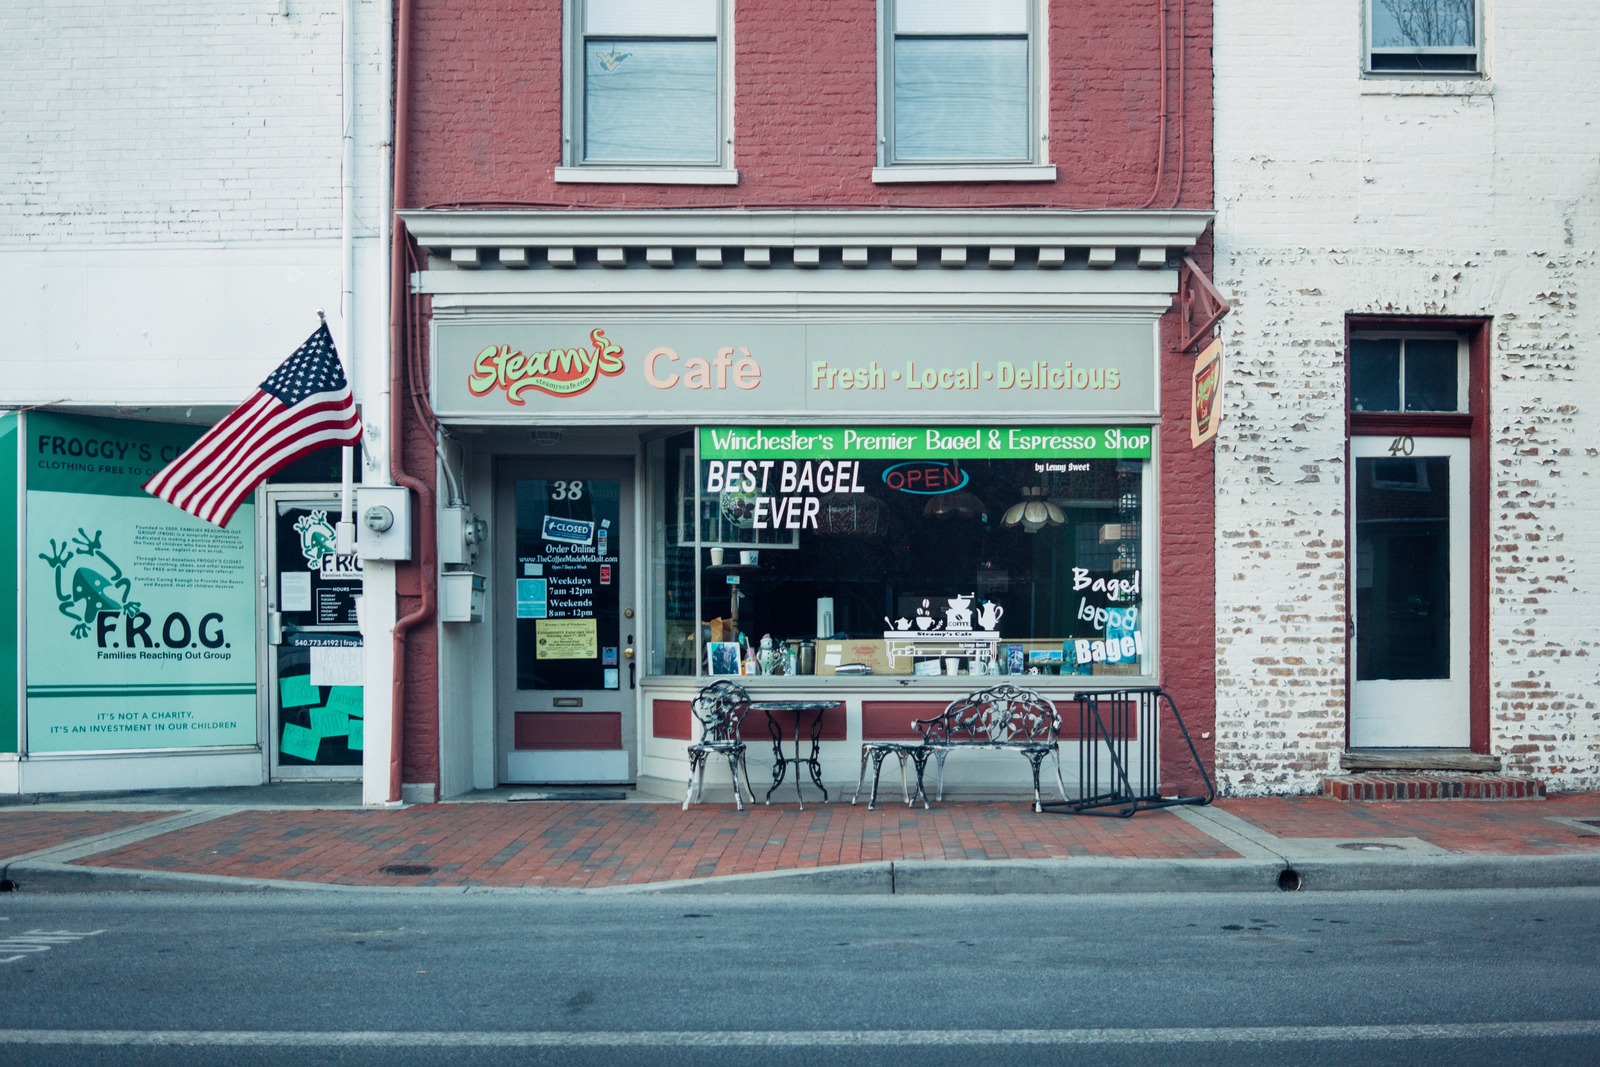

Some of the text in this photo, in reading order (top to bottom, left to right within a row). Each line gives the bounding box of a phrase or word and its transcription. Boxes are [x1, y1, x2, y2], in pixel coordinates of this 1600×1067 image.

[468, 328, 625, 405] Steamy's
[811, 360, 1121, 390] Fresh Local Delicious
[535, 377, 591, 391] steamyscafe.com
[38, 435, 153, 462] FROGGY'S
[711, 429, 1150, 451] Winchester's Premier Bagel & Espresso Shop
[1388, 436, 1415, 456] 40
[38, 460, 95, 472] CLOTHING
[98, 465, 125, 475] FREE
[128, 467, 141, 476] TO
[1035, 462, 1090, 472] by Lenny Sweet
[706, 460, 866, 493] BEST BAGEL
[886, 467, 960, 490] OPEN
[551, 480, 584, 500] 38
[752, 497, 820, 529] EVER
[556, 523, 589, 534] CLOSED
[545, 544, 596, 553] Order Online
[549, 577, 592, 586] Weekdays
[1071, 567, 1140, 602] Bagel
[549, 587, 567, 595] 7am
[550, 599, 593, 607] Weekends
[549, 609, 566, 617] 8am
[573, 609, 593, 618] 12pm
[97, 611, 232, 649] F.R.O.G.
[97, 651, 232, 661] Families Reaching Out Group
[1074, 631, 1144, 665] Bagel
[97, 713, 115, 721] IT'S
[142, 712, 149, 720] A
[50, 726, 69, 734] IT'S
[72, 725, 87, 733] AN
[89, 724, 151, 733] INVESTMENT
[170, 723, 188, 731] OUR
[191, 721, 237, 730] CHILDREN
